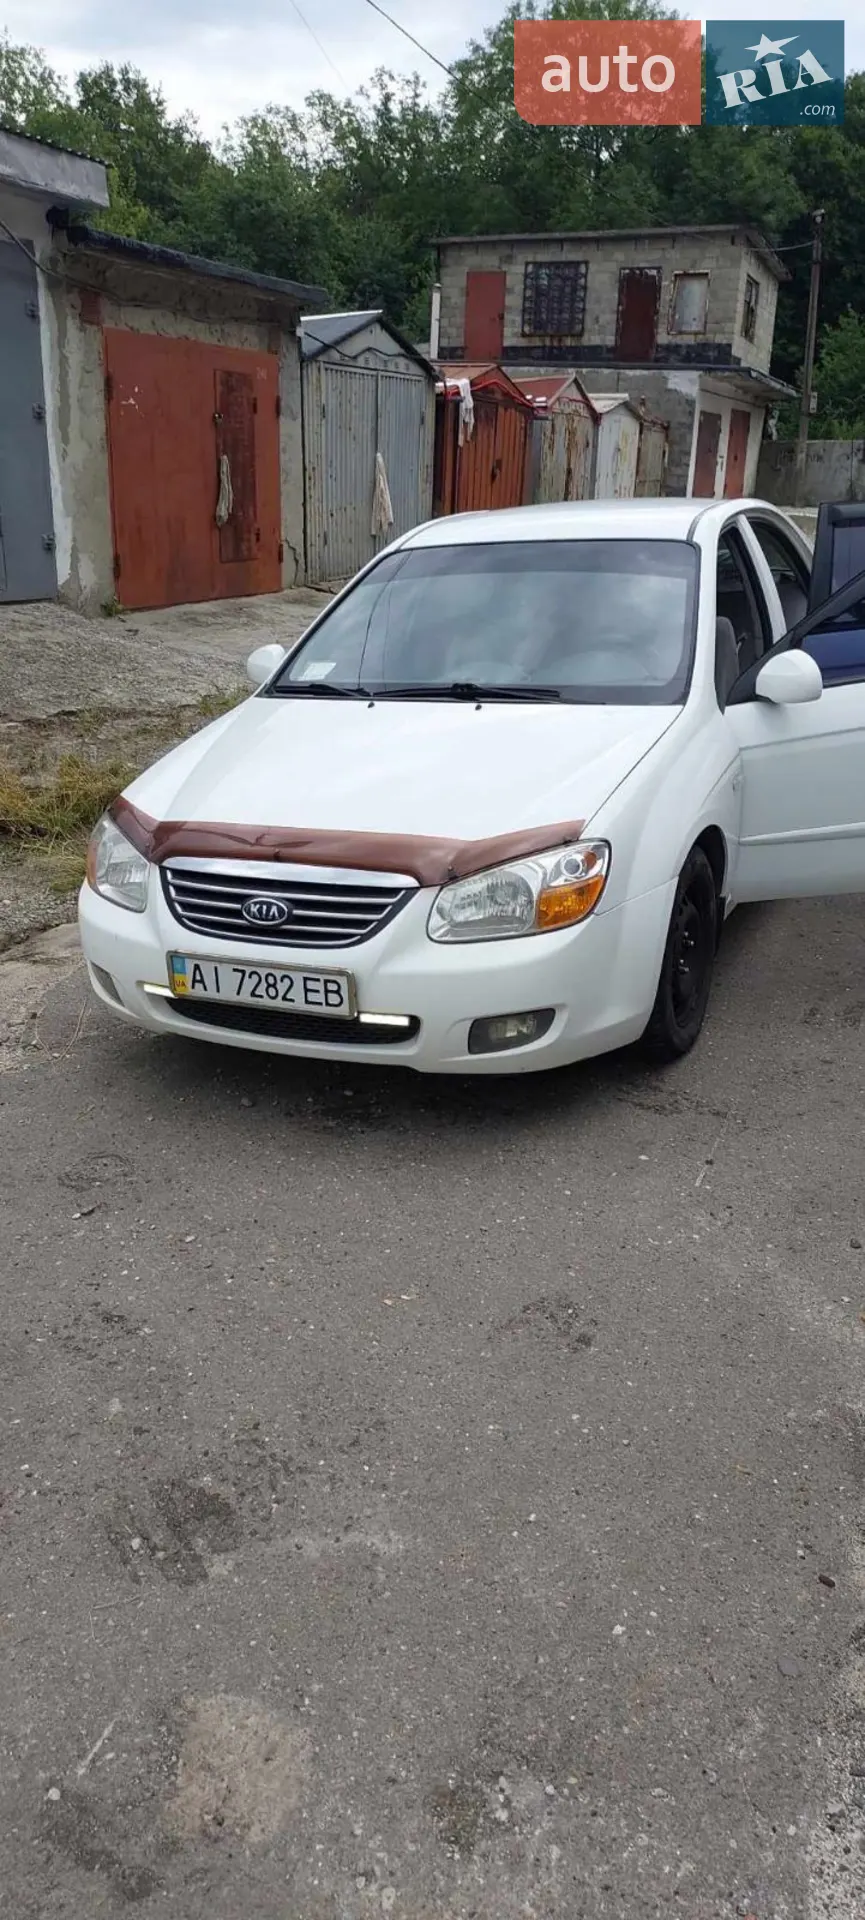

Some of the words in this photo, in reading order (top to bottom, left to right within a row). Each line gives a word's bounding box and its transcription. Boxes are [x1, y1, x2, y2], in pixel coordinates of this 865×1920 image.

[250, 903, 280, 919] KIA
[174, 979, 187, 989] UA
[191, 963, 220, 993] AI
[232, 967, 295, 1003] 7282
[303, 976, 344, 1008] EB
